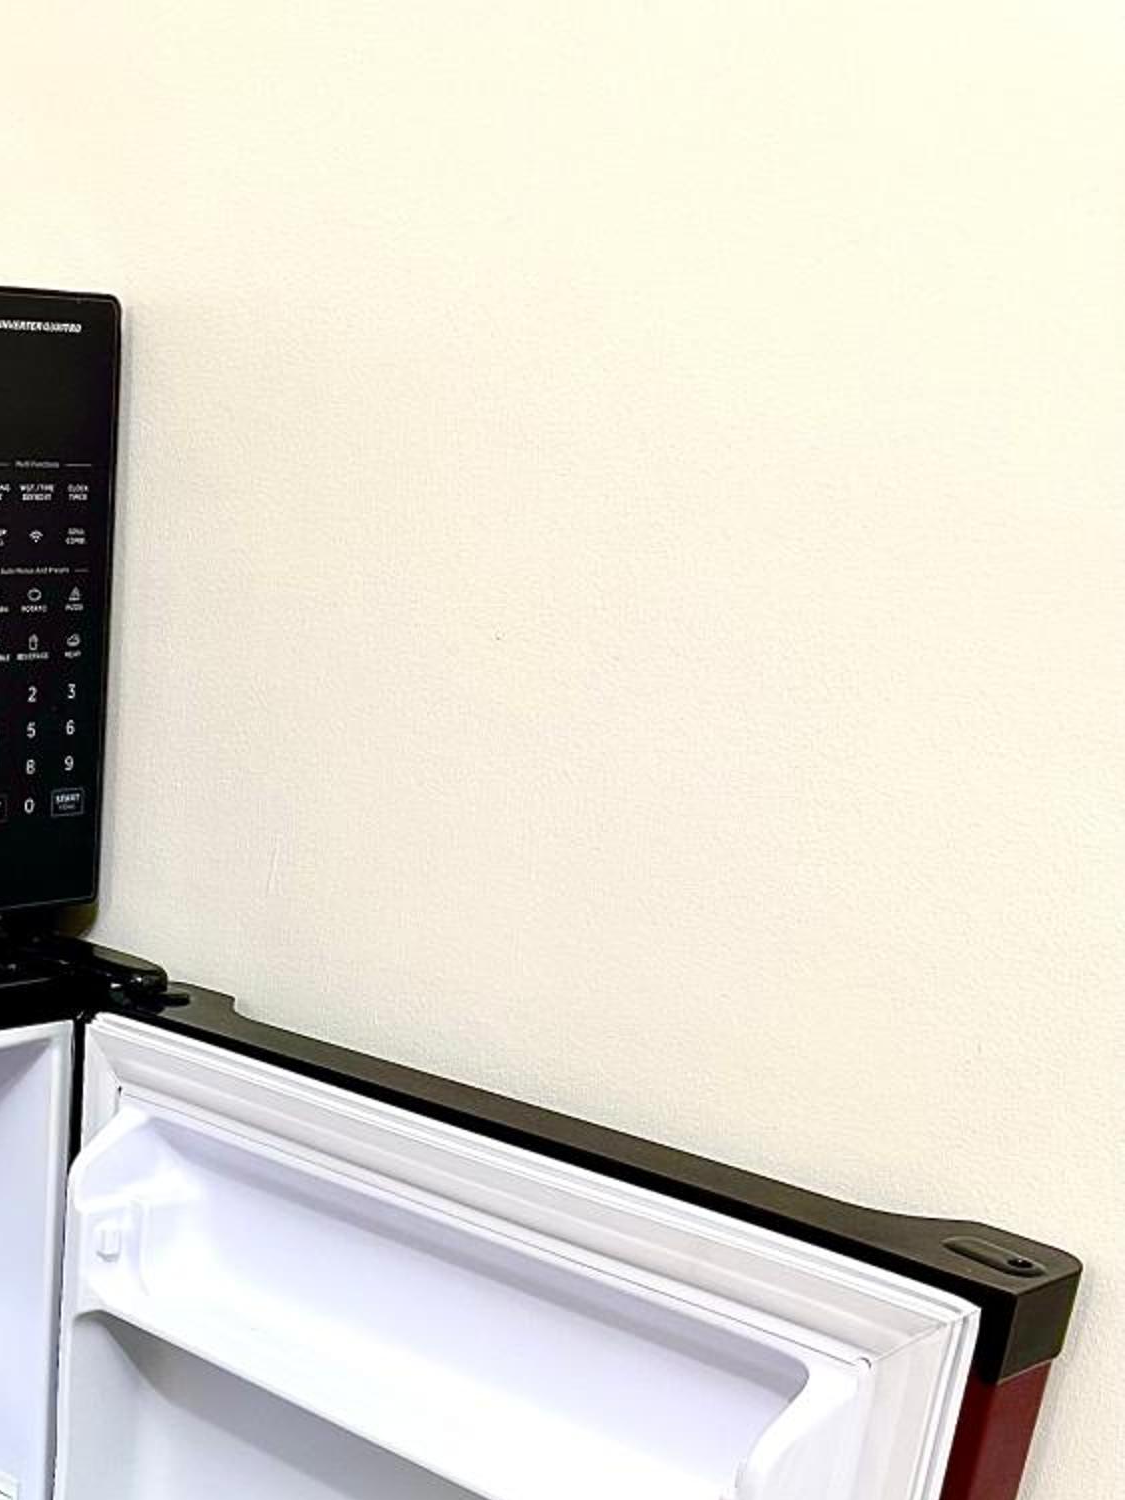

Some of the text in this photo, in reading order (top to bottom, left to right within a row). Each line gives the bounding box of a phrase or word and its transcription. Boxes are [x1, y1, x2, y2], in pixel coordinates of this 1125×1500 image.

[27, 685, 38, 703] 2
[68, 683, 76, 699] 3
[26, 721, 36, 739] 5
[66, 719, 75, 735] 6
[26, 759, 36, 775] 8
[64, 755, 74, 771] 9
[24, 797, 35, 814] 0
